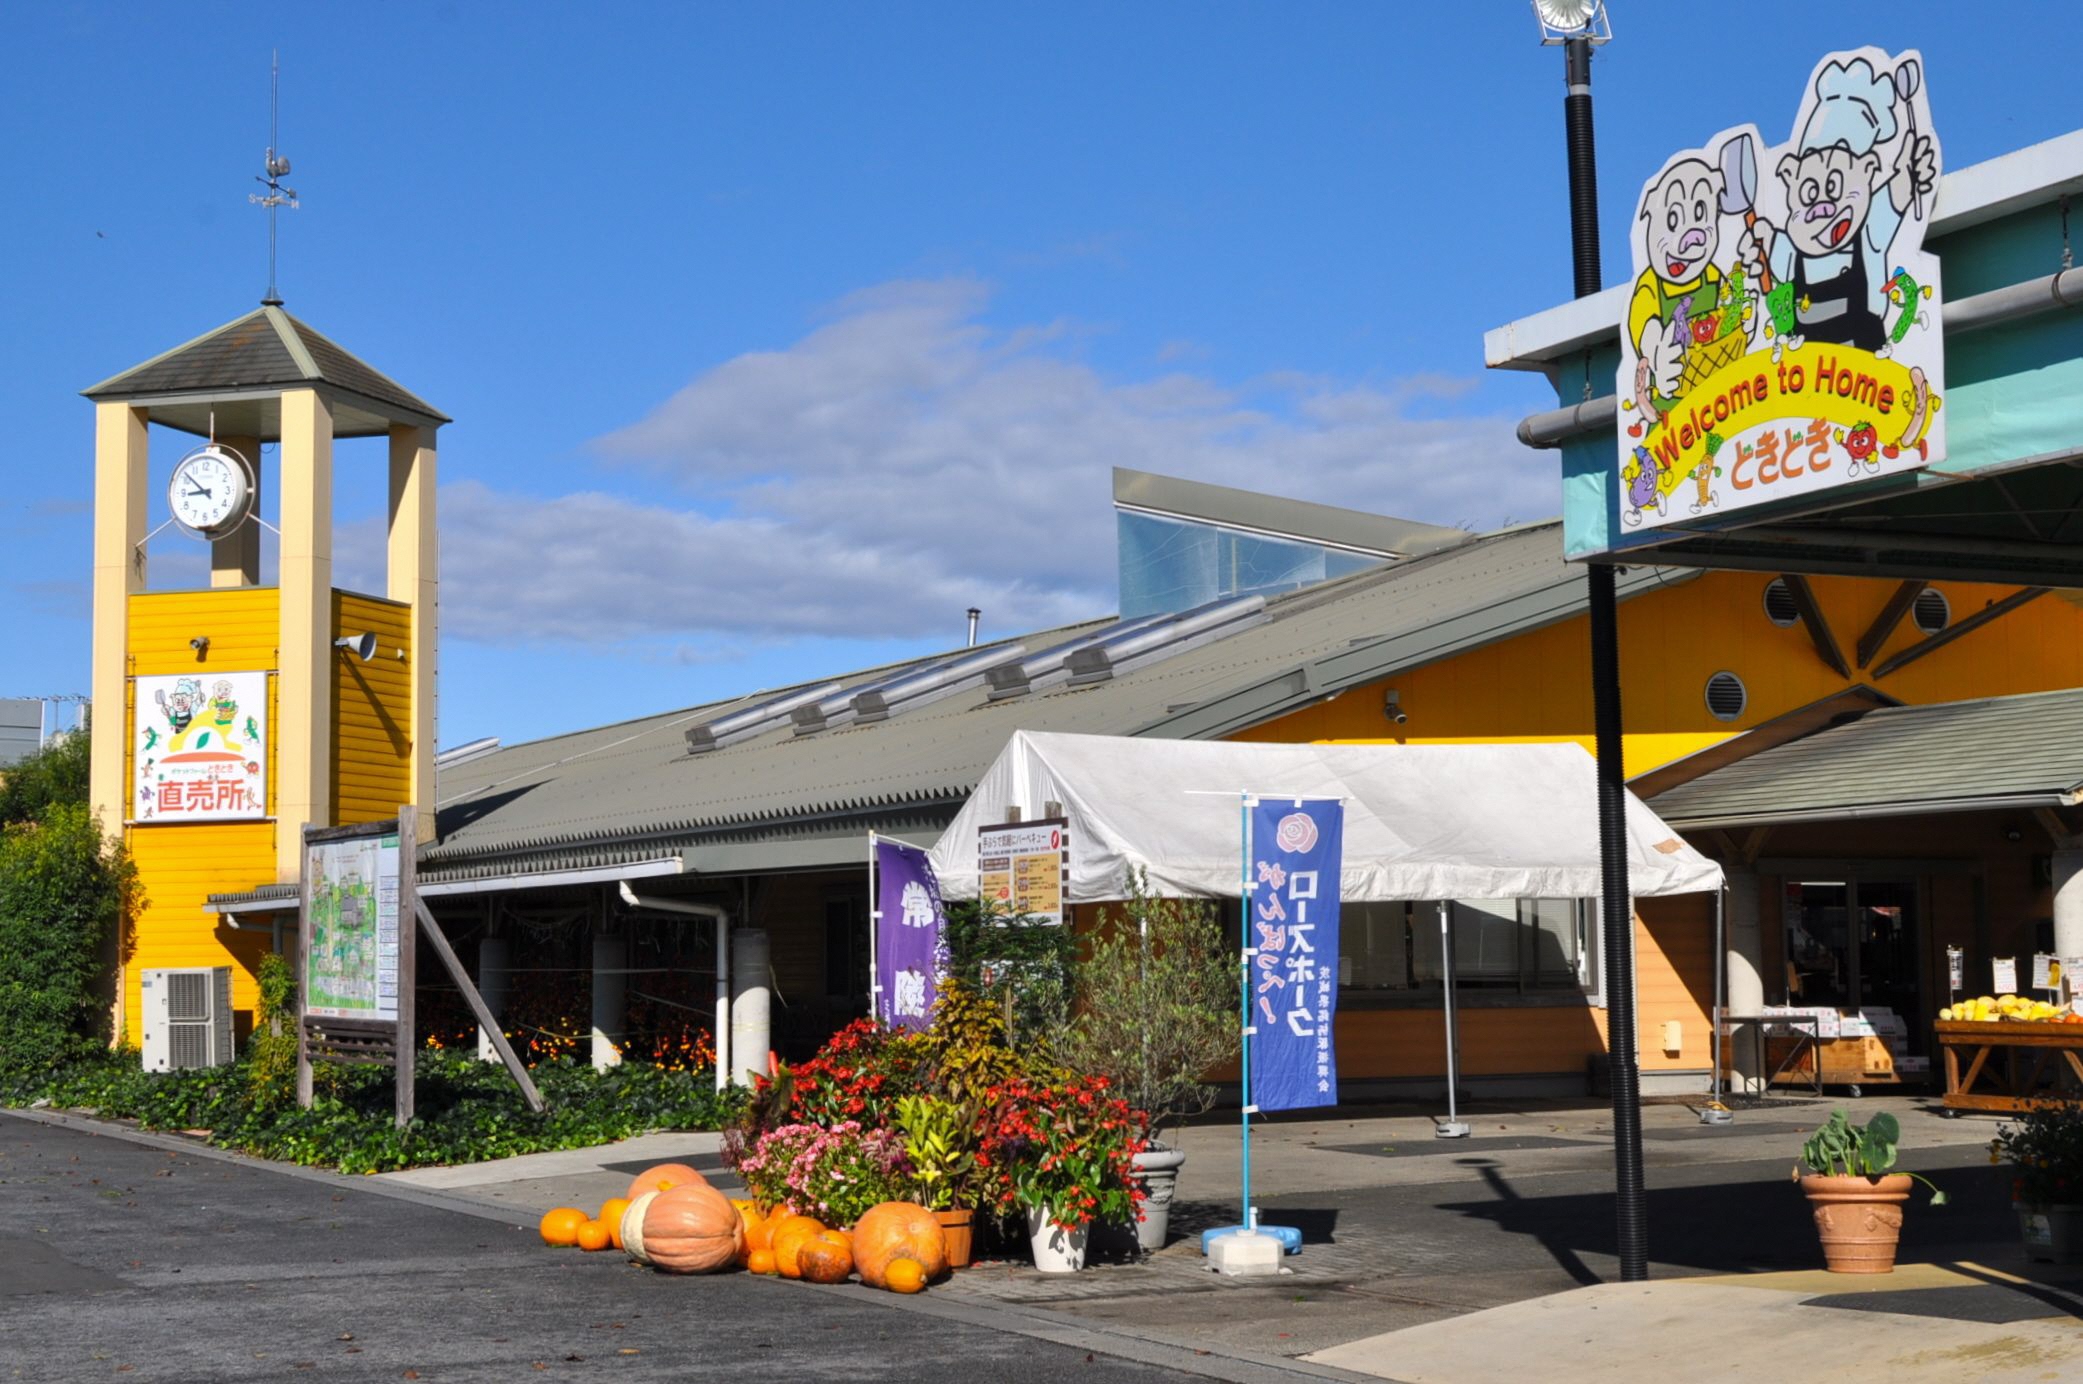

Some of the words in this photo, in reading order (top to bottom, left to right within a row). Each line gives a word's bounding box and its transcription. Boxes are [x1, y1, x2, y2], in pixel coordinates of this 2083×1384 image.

[1654, 373, 1769, 470] Welcome
[1777, 360, 1805, 395] to
[1814, 355, 1895, 415] Home
[1730, 416, 1832, 491] どきどき
[157, 778, 245, 813] 直売所
